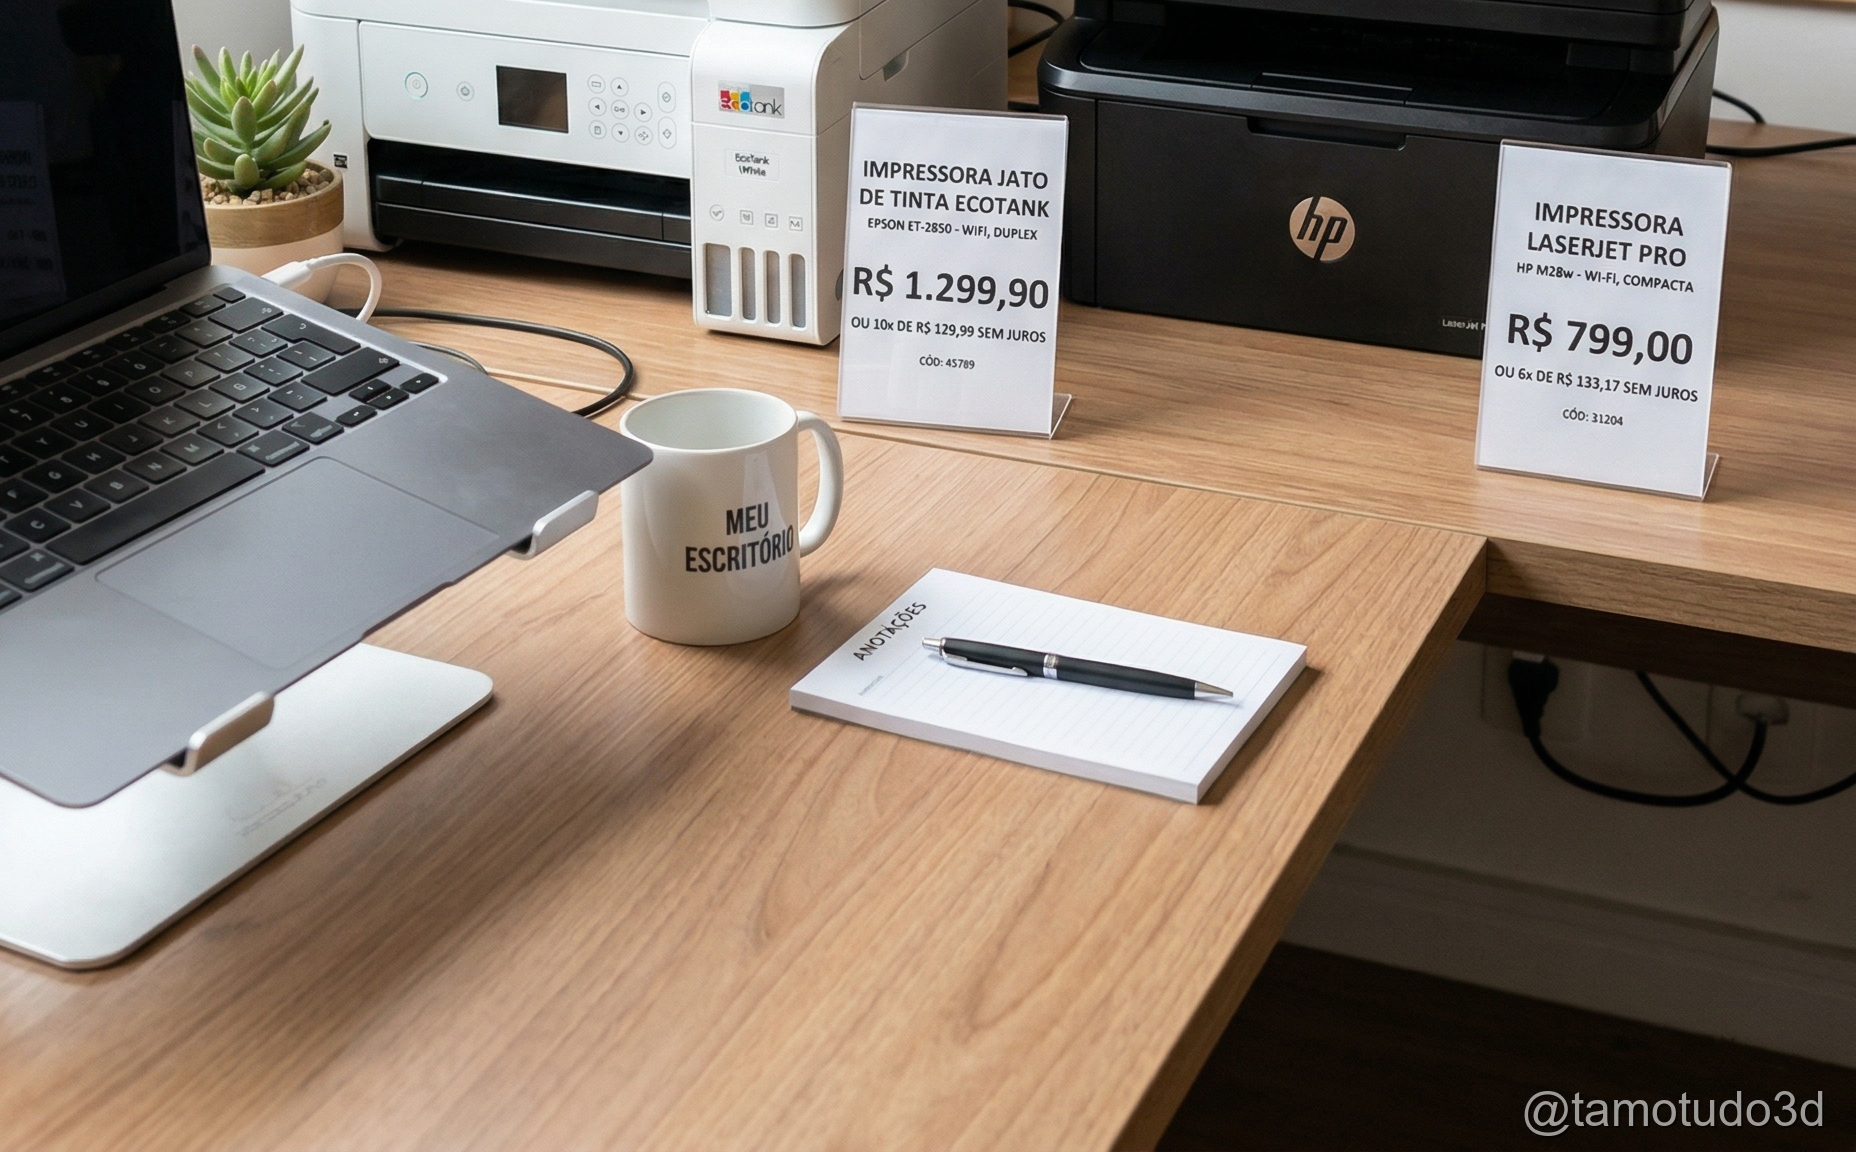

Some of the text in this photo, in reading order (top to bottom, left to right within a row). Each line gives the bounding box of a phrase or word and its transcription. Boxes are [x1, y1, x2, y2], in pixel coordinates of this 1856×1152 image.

[864, 161, 1048, 189] IMPRESSORA JATO
[860, 188, 1049, 217] DE TINTA ECOTANK
[1536, 202, 1683, 236] IMPRESSORA
[868, 218, 904, 230] EPSON
[962, 225, 990, 239] WIFI,
[994, 227, 1037, 240] DUPLEX
[1297, 197, 1348, 261] hp
[1528, 232, 1686, 267] LASERJET PRO
[854, 264, 1048, 311] R$ 1.299,90
[1517, 262, 1533, 273] HP
[1537, 265, 1573, 278] M28w
[1585, 270, 1619, 286] WI-FI,
[1623, 275, 1693, 292] COMPACTA
[852, 317, 1045, 342] OU 10x DE R$ 129,99 SEM JUROS
[1508, 312, 1692, 365] R$ 799,00
[946, 359, 975, 369] 45789
[1495, 365, 1698, 402] OU 6x DE R$ 133,17 SEM JUROS
[1563, 407, 1623, 425] CÓD: 31204
[726, 502, 768, 535] MEU
[686, 525, 793, 572] ESCRITÓRIO
[853, 602, 926, 661] ANOTAÇÕES
